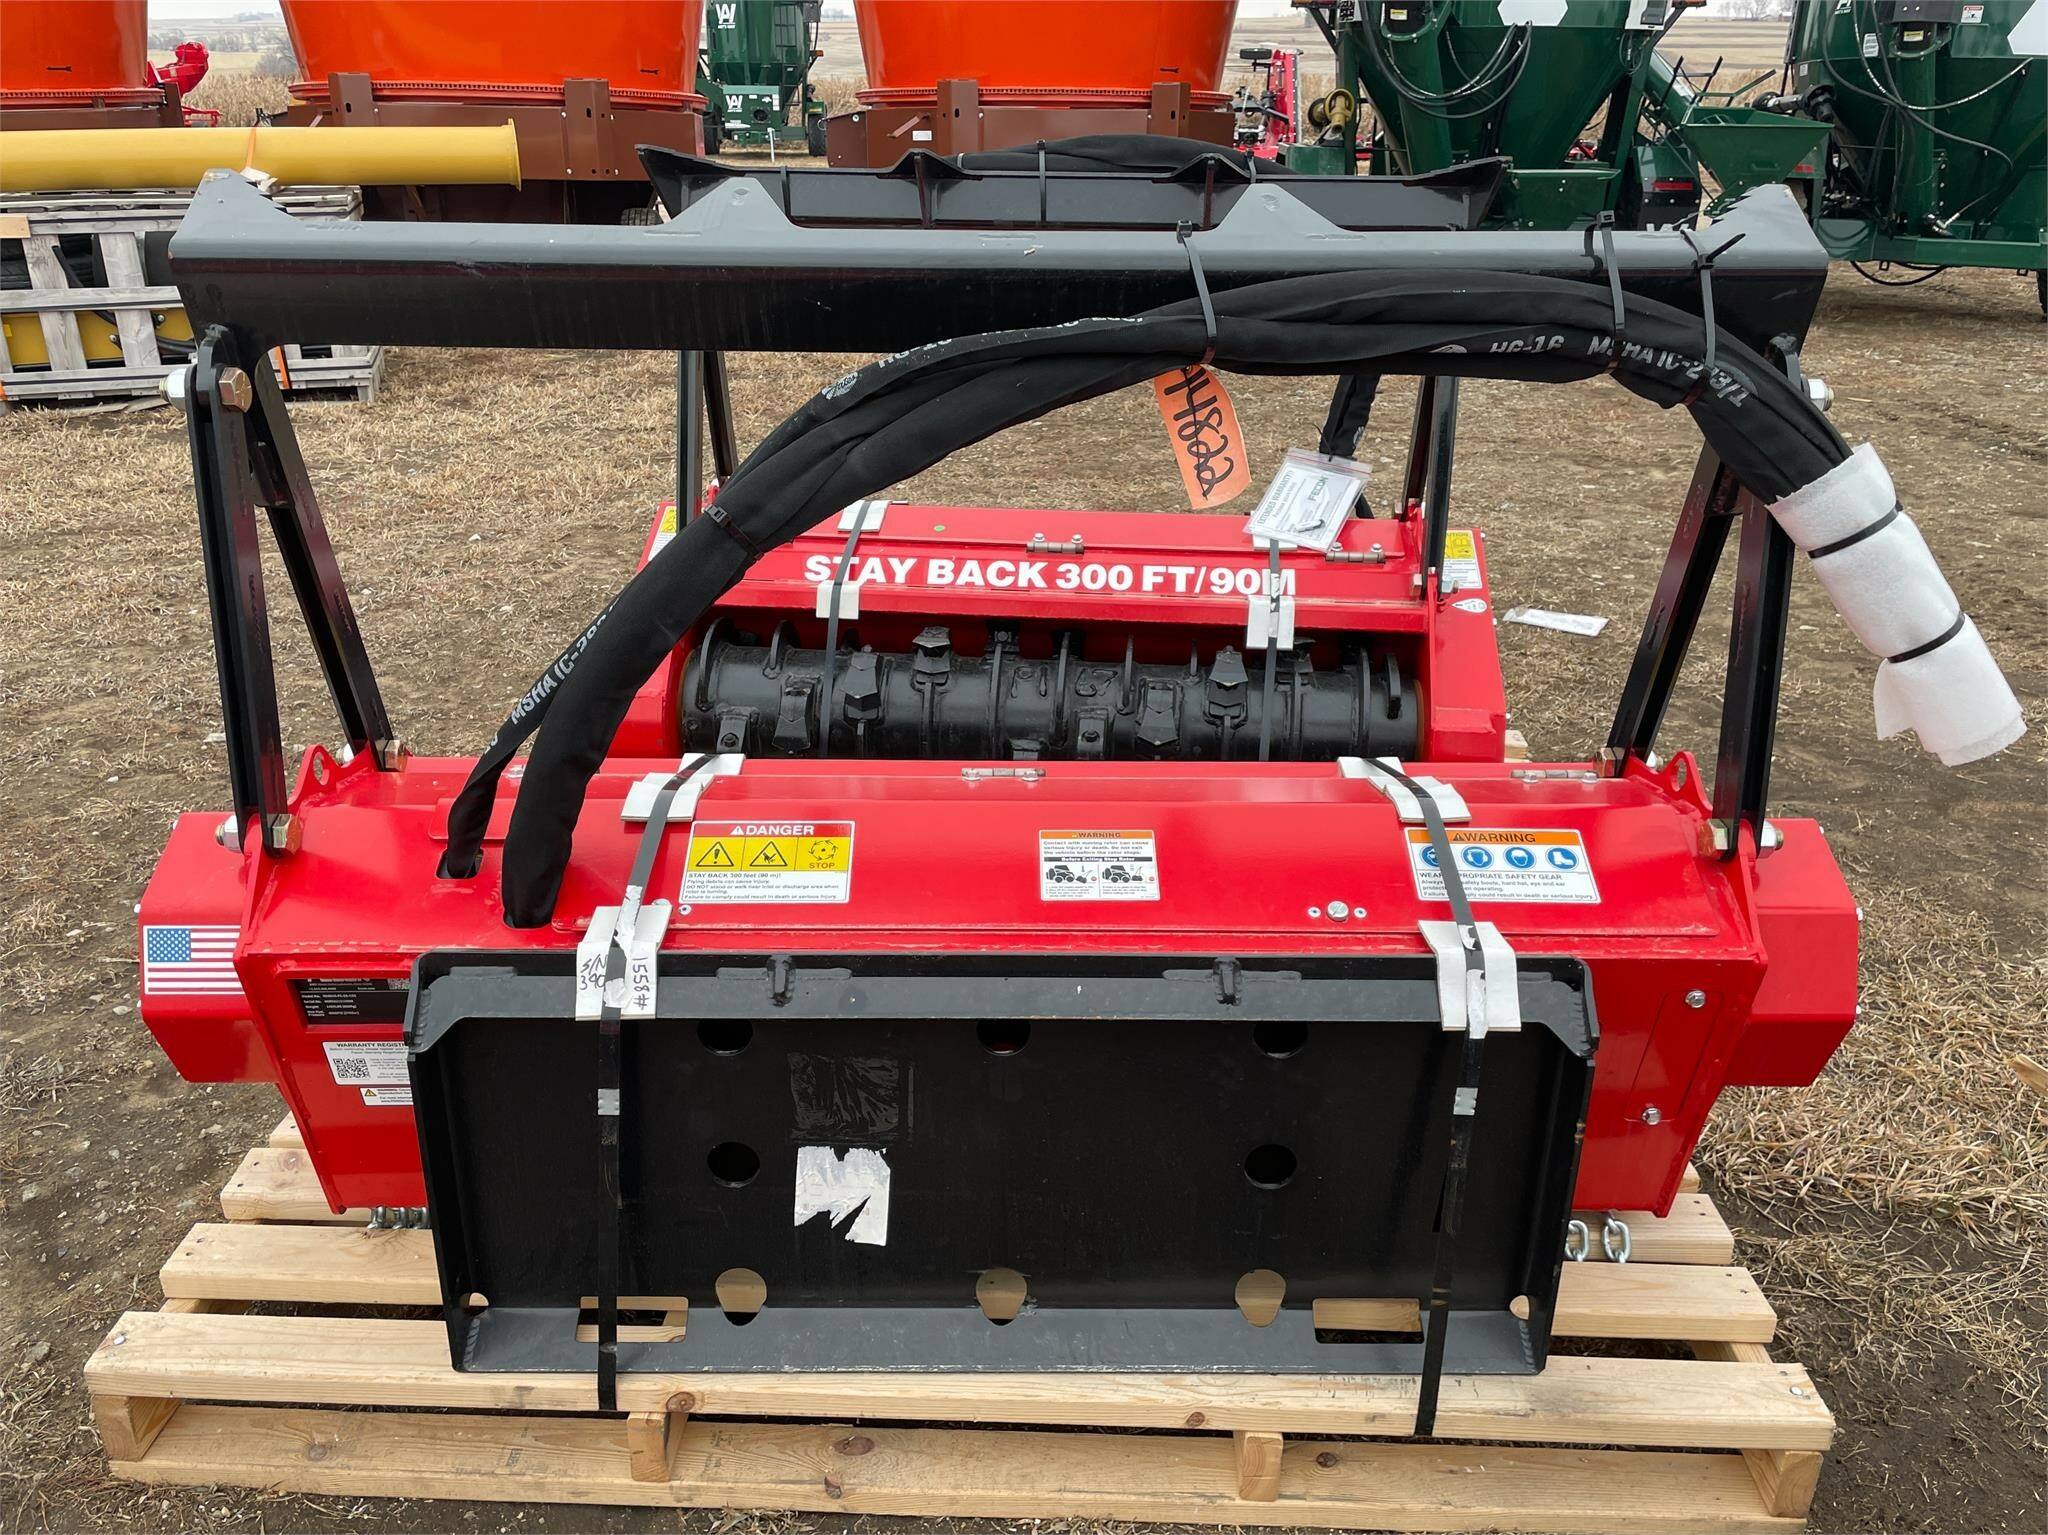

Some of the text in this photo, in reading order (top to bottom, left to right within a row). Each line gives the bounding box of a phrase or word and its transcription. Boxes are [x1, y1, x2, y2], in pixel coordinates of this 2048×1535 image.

[805, 553, 918, 584] STAY
[926, 557, 1047, 589] BACK
[1055, 562, 1133, 592] 300
[510, 673, 558, 725] MSHA
[745, 825, 815, 836] DANGER
[1464, 832, 1536, 843] WARNING
[808, 862, 836, 870] STOP
